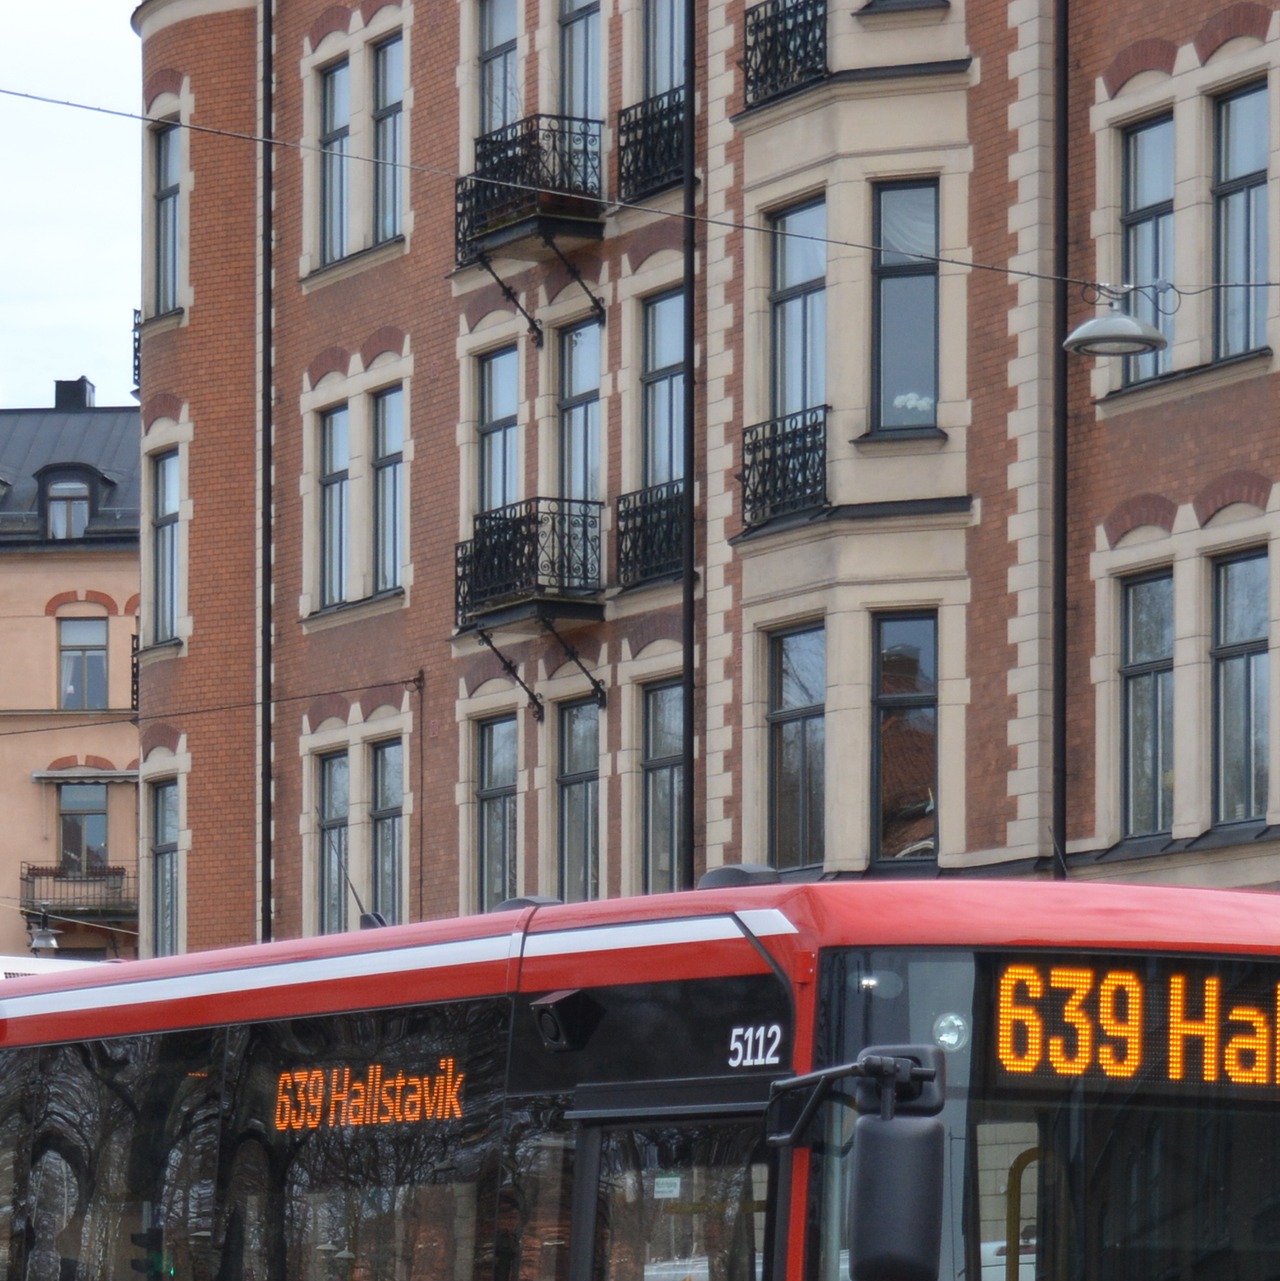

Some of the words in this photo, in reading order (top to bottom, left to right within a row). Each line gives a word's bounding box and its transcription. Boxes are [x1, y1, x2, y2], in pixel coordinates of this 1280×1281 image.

[728, 1024, 781, 1068] 5112
[998, 964, 1143, 1078] 639
[275, 1069, 324, 1131] 639
[328, 1057, 465, 1127] Hallstavik
